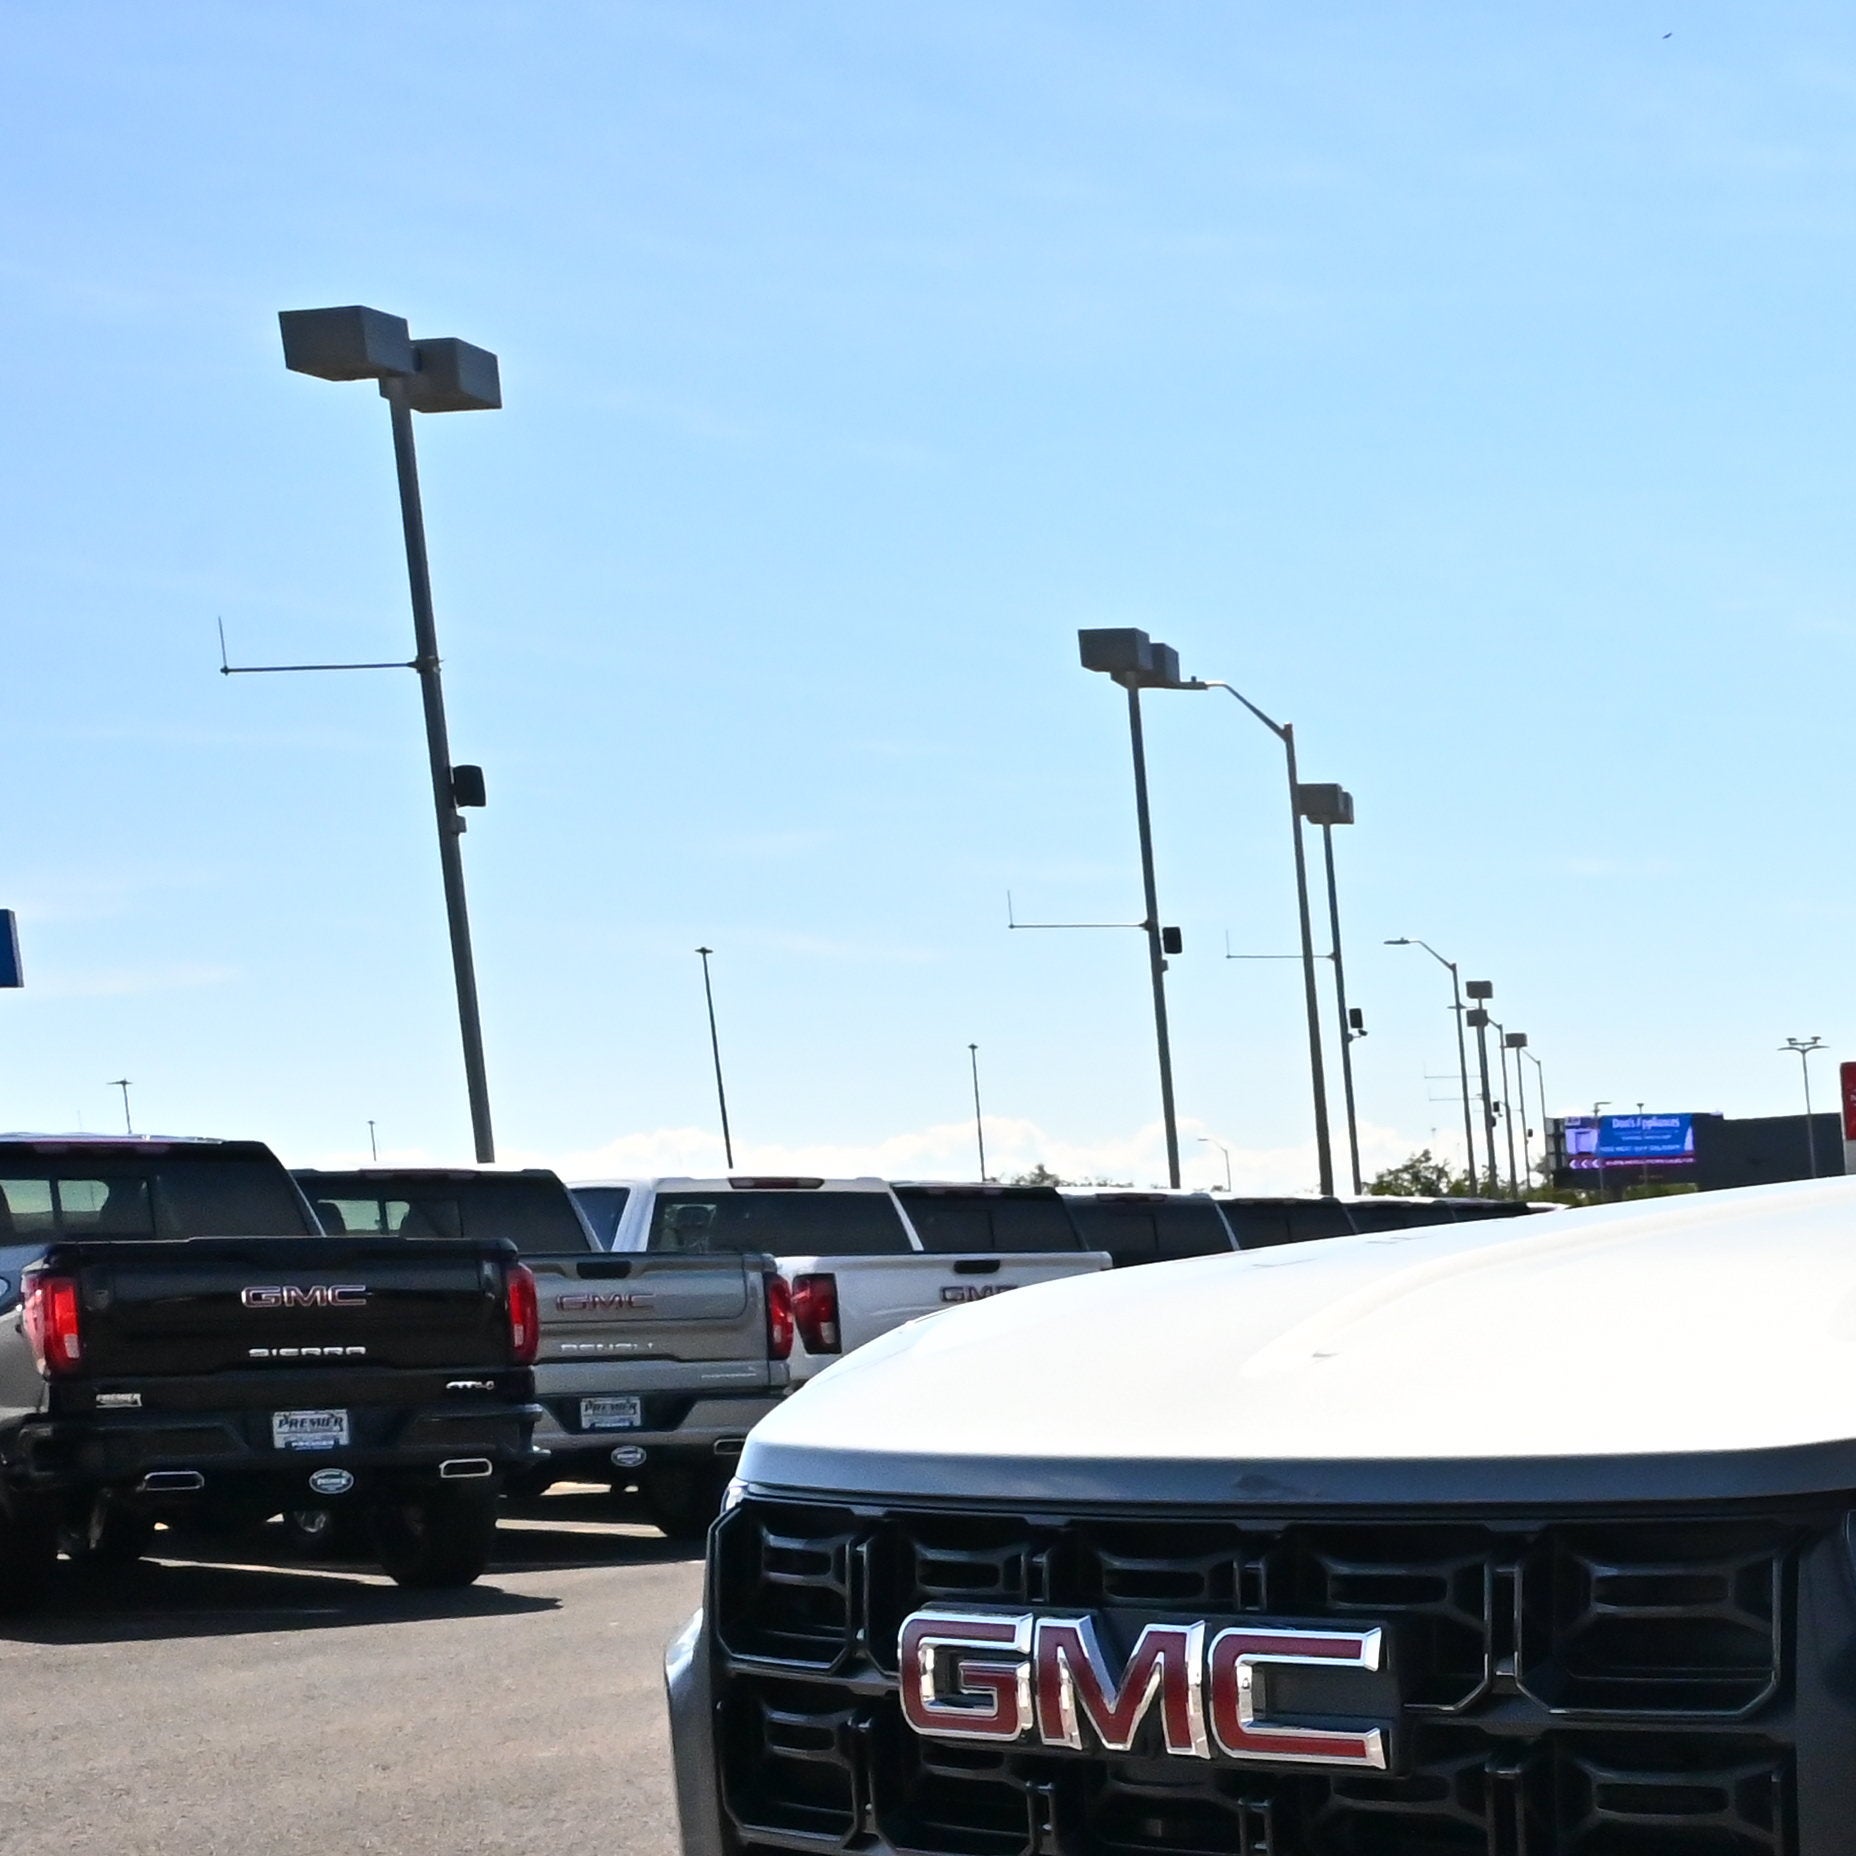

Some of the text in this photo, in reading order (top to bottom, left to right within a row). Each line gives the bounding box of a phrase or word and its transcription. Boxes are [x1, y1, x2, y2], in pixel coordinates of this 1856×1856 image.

[241, 1285, 367, 1308] GMC
[556, 1294, 654, 1311] GMC
[249, 1346, 366, 1357] SIERRA
[897, 1610, 1387, 1769] GMC
